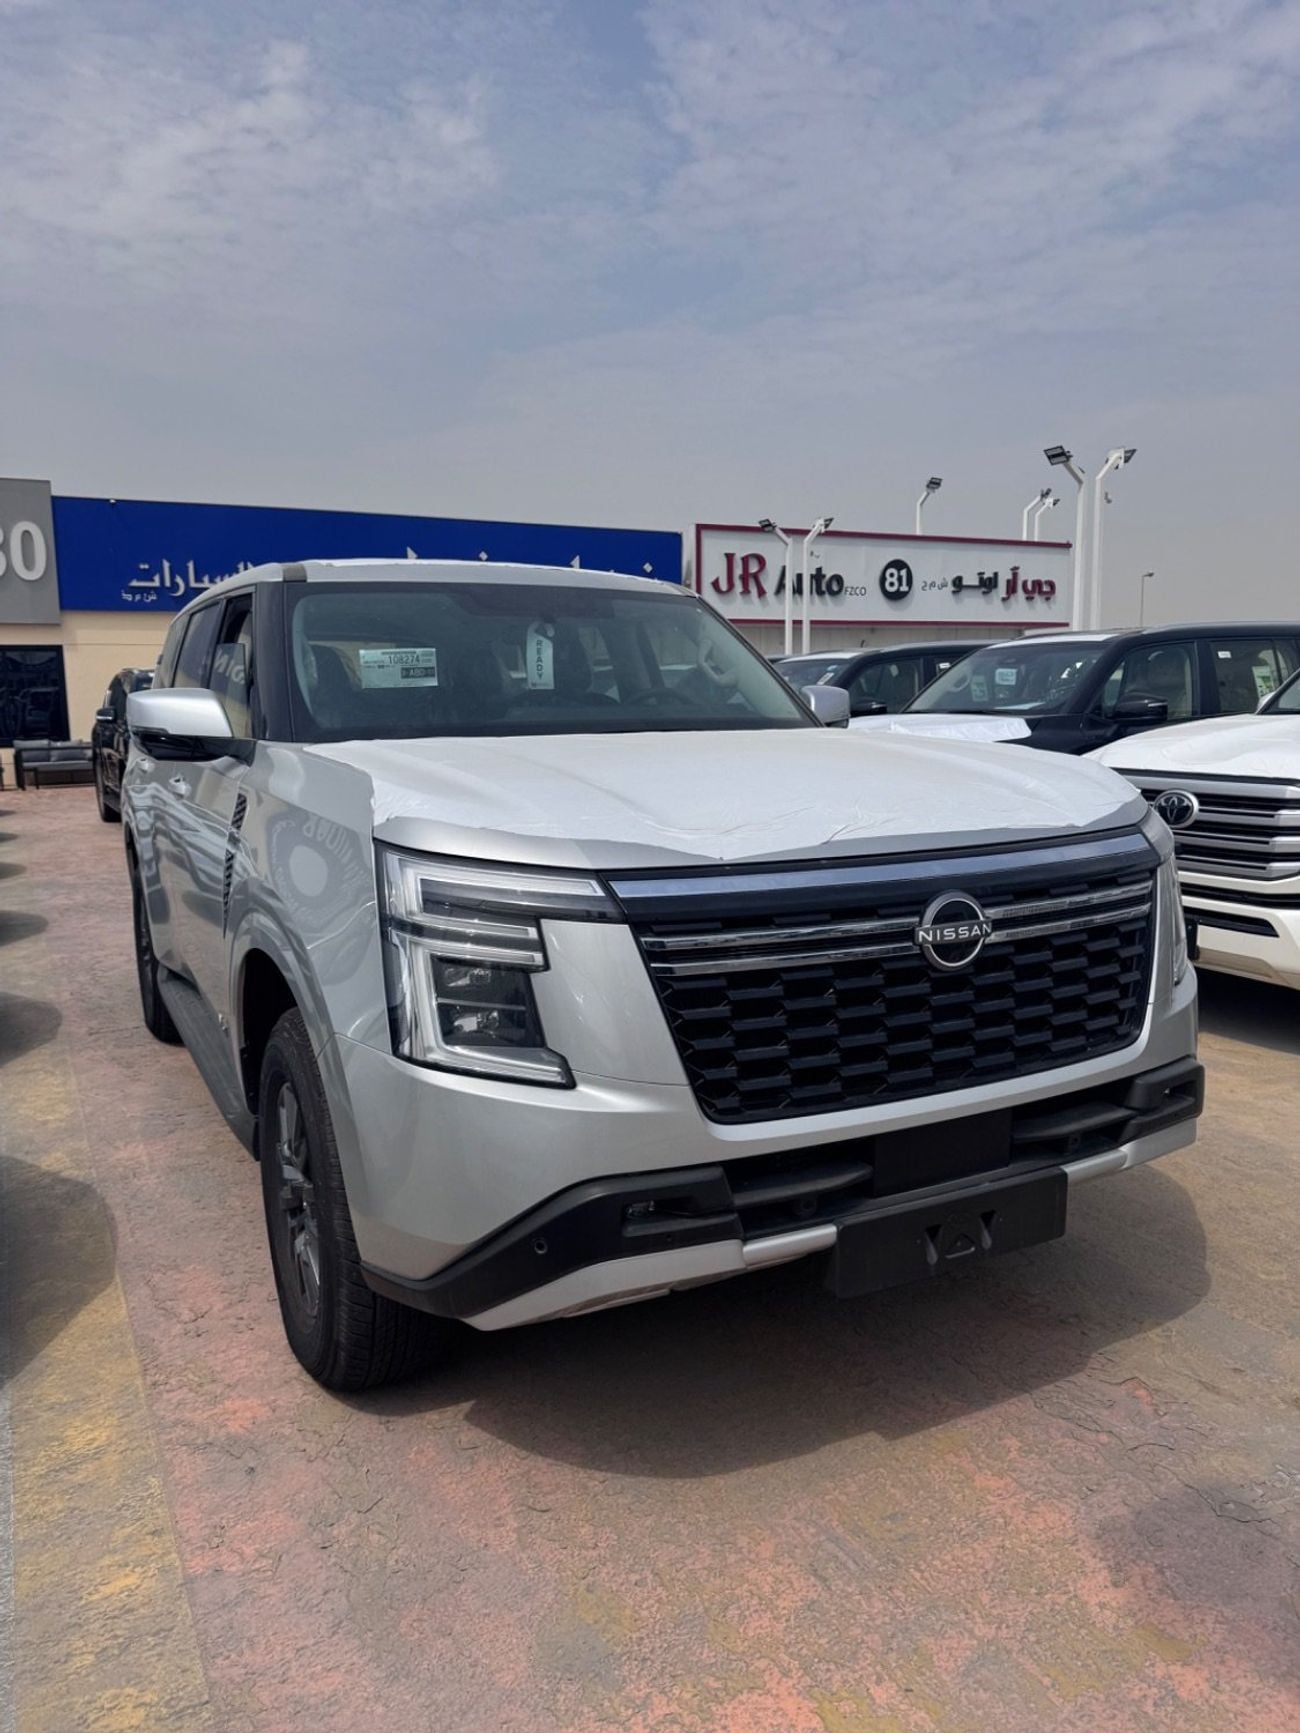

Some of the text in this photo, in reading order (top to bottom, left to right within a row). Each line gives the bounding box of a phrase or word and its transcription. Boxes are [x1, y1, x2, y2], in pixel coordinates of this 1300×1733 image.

[0, 520, 47, 581] 0
[128, 558, 256, 597] يارات
[711, 552, 867, 598] JR Auto FZCO
[884, 567, 910, 593] 81
[1022, 578, 1057, 601] جي
[918, 923, 992, 943] NISSAN
